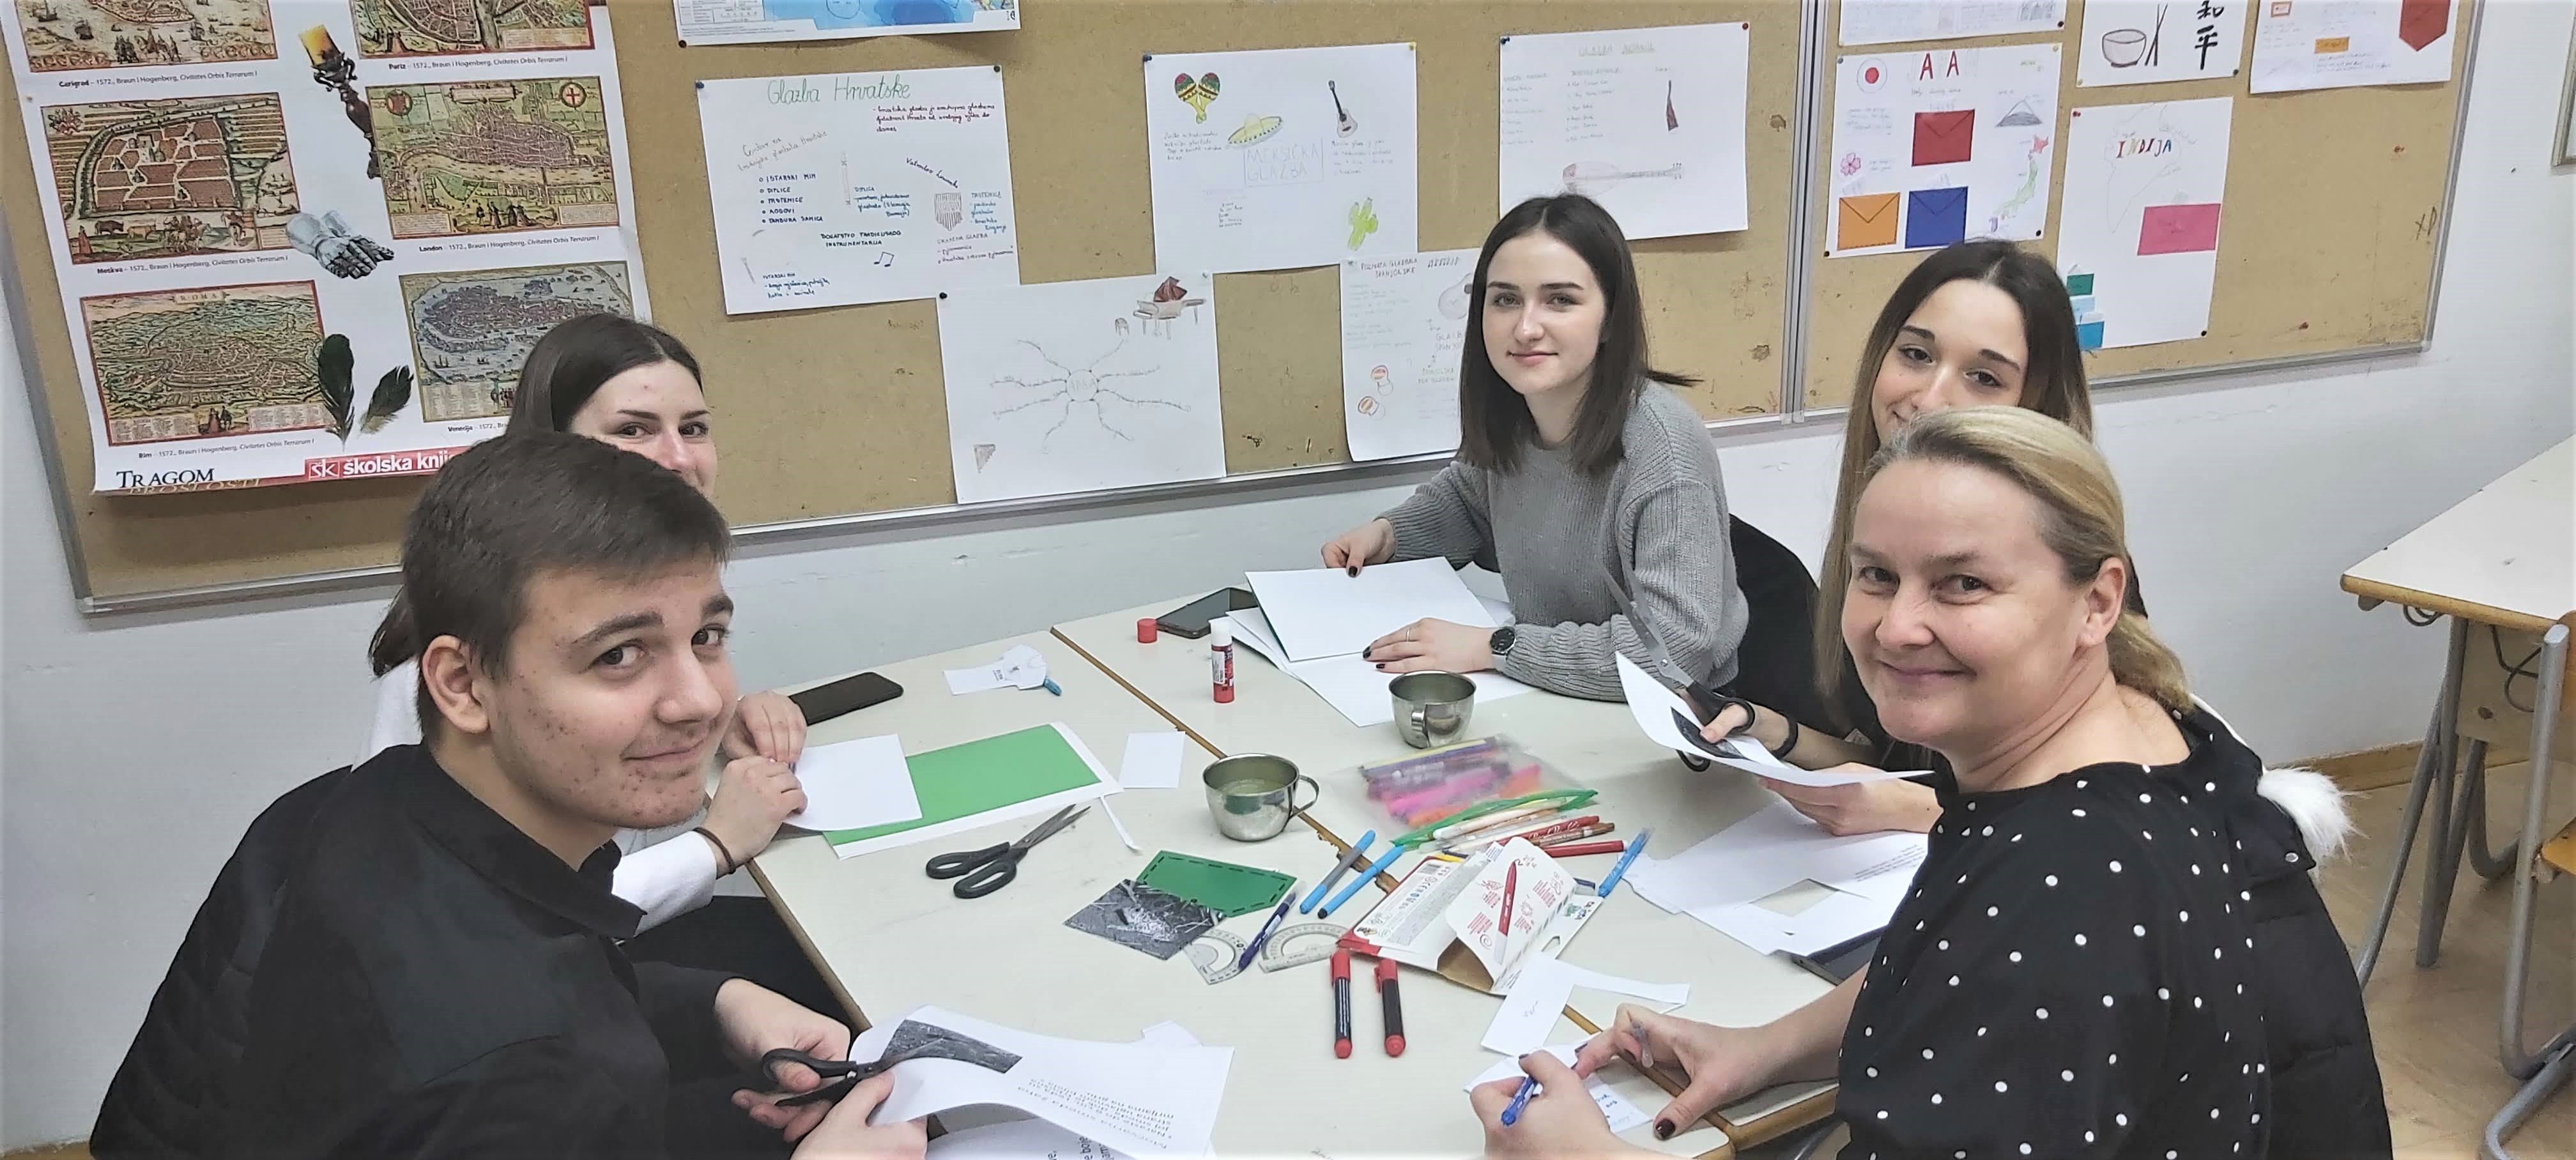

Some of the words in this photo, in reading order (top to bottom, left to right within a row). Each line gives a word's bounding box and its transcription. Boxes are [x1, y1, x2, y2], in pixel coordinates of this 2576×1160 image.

[59, 80, 89, 88] Carigrad
[767, 79, 820, 105] Glazba
[834, 74, 911, 102] Hrvatske
[2115, 138, 2172, 159] INDIJA
[767, 174, 798, 183] ISTARSKI
[1247, 162, 1308, 181] GLAZBA
[97, 266, 123, 275] Moskva
[343, 455, 412, 475] školska
[116, 468, 215, 489] TRAGOM
